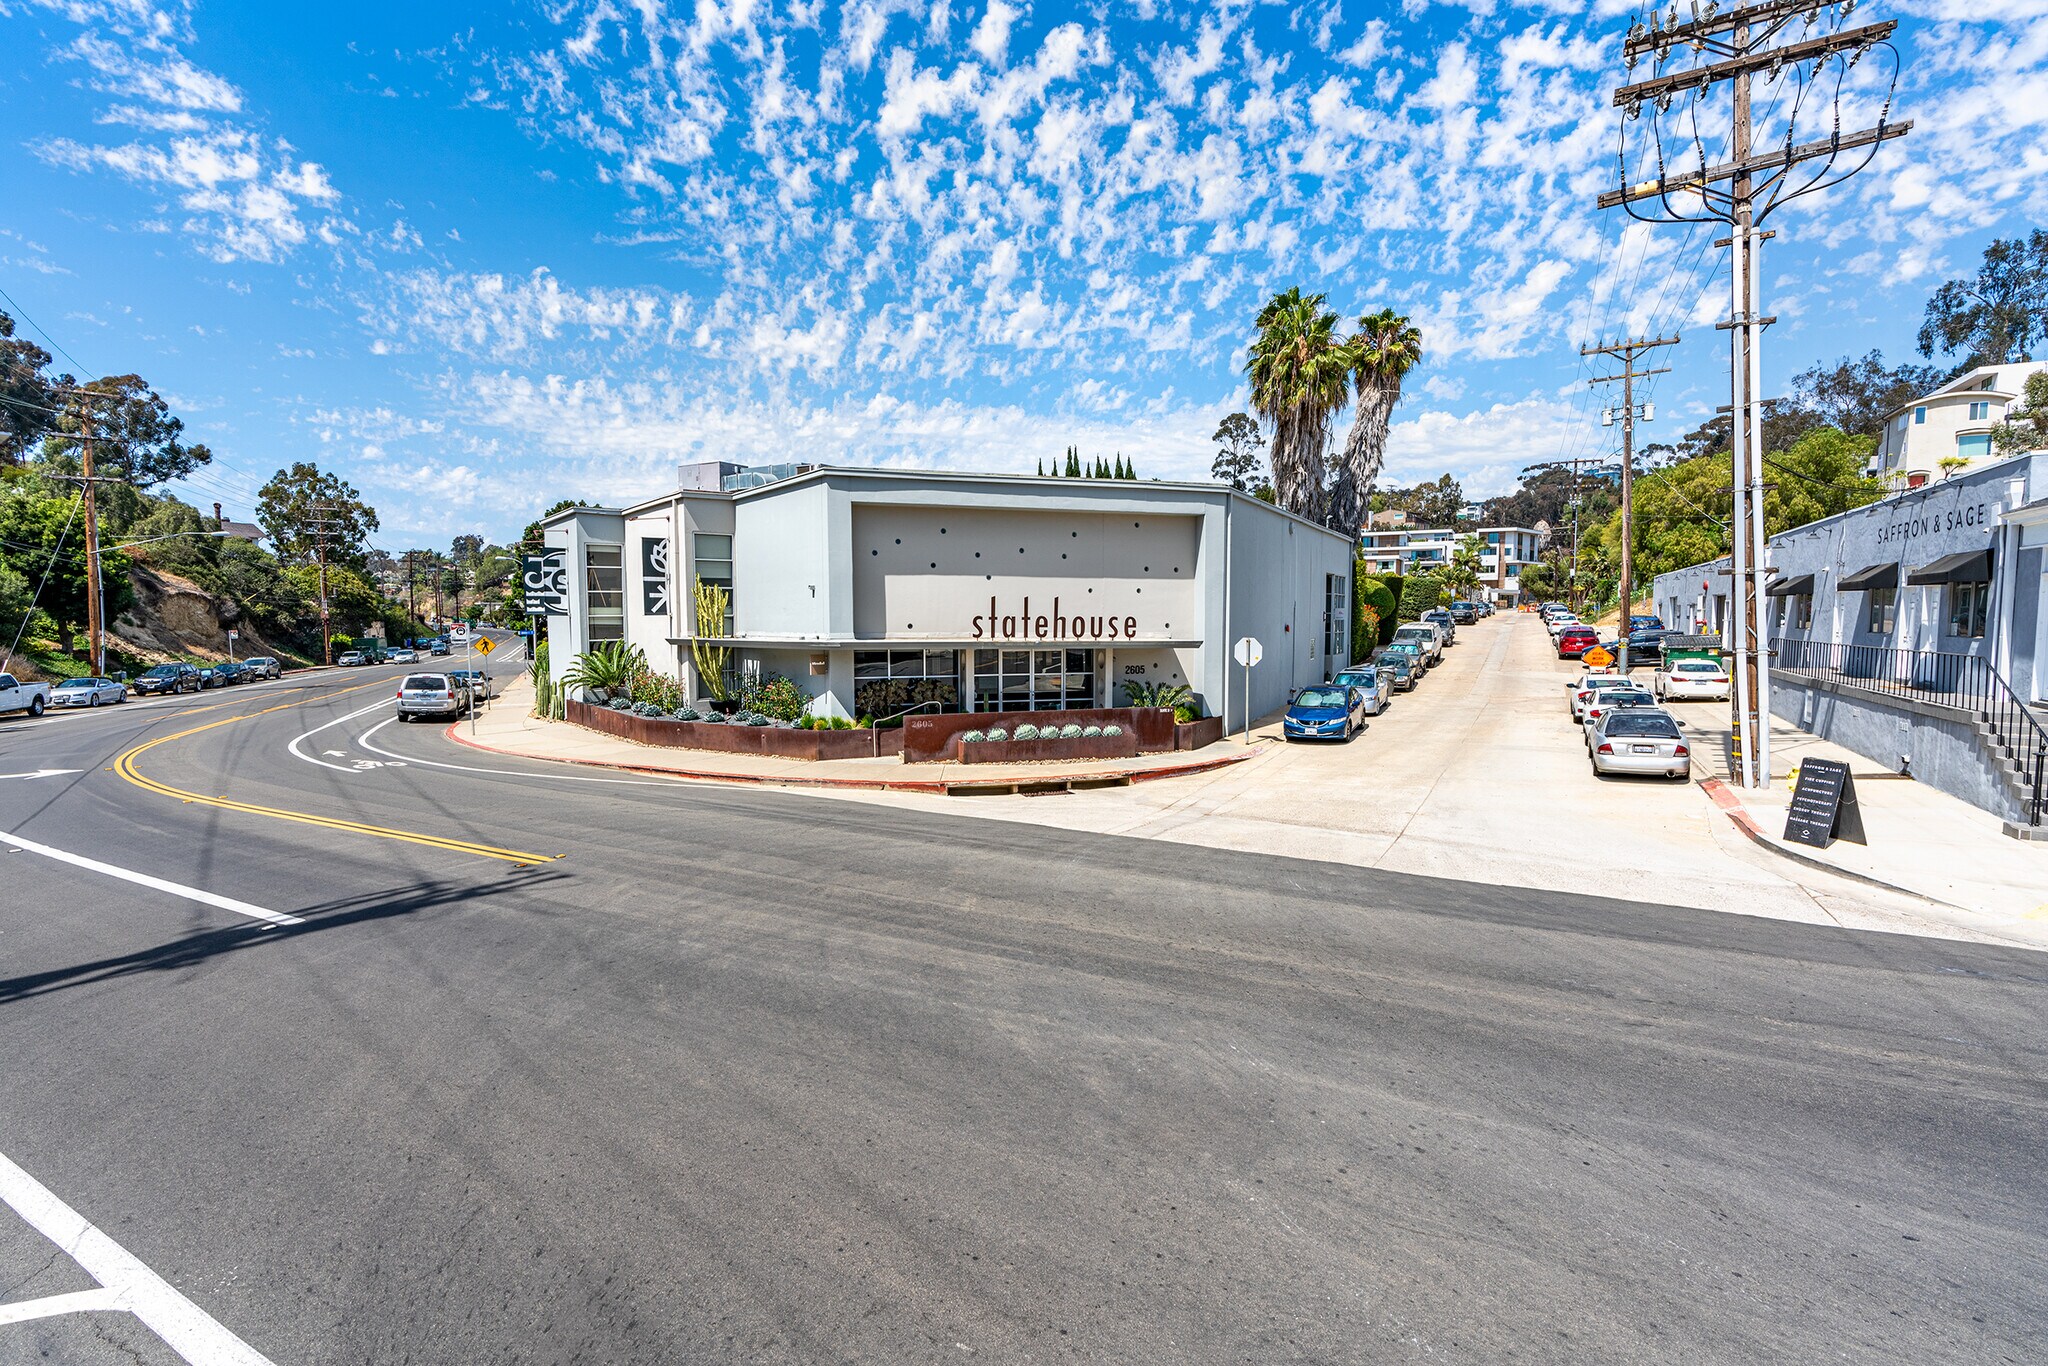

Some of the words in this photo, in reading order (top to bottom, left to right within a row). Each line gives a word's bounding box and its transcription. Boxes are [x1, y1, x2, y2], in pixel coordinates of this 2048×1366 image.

[1877, 517, 1929, 544] SAFFRON
[1933, 514, 1941, 533] &
[1946, 503, 1985, 531] SAGE
[972, 595, 1137, 640] statehouse
[1125, 665, 1145, 674] 2605
[911, 720, 933, 728] 2605
[1801, 787, 1833, 795] ACUPUNCTURE
[1796, 796, 1833, 806] PSYCHOTHERAPY
[1810, 820, 1829, 828] THERAPY
